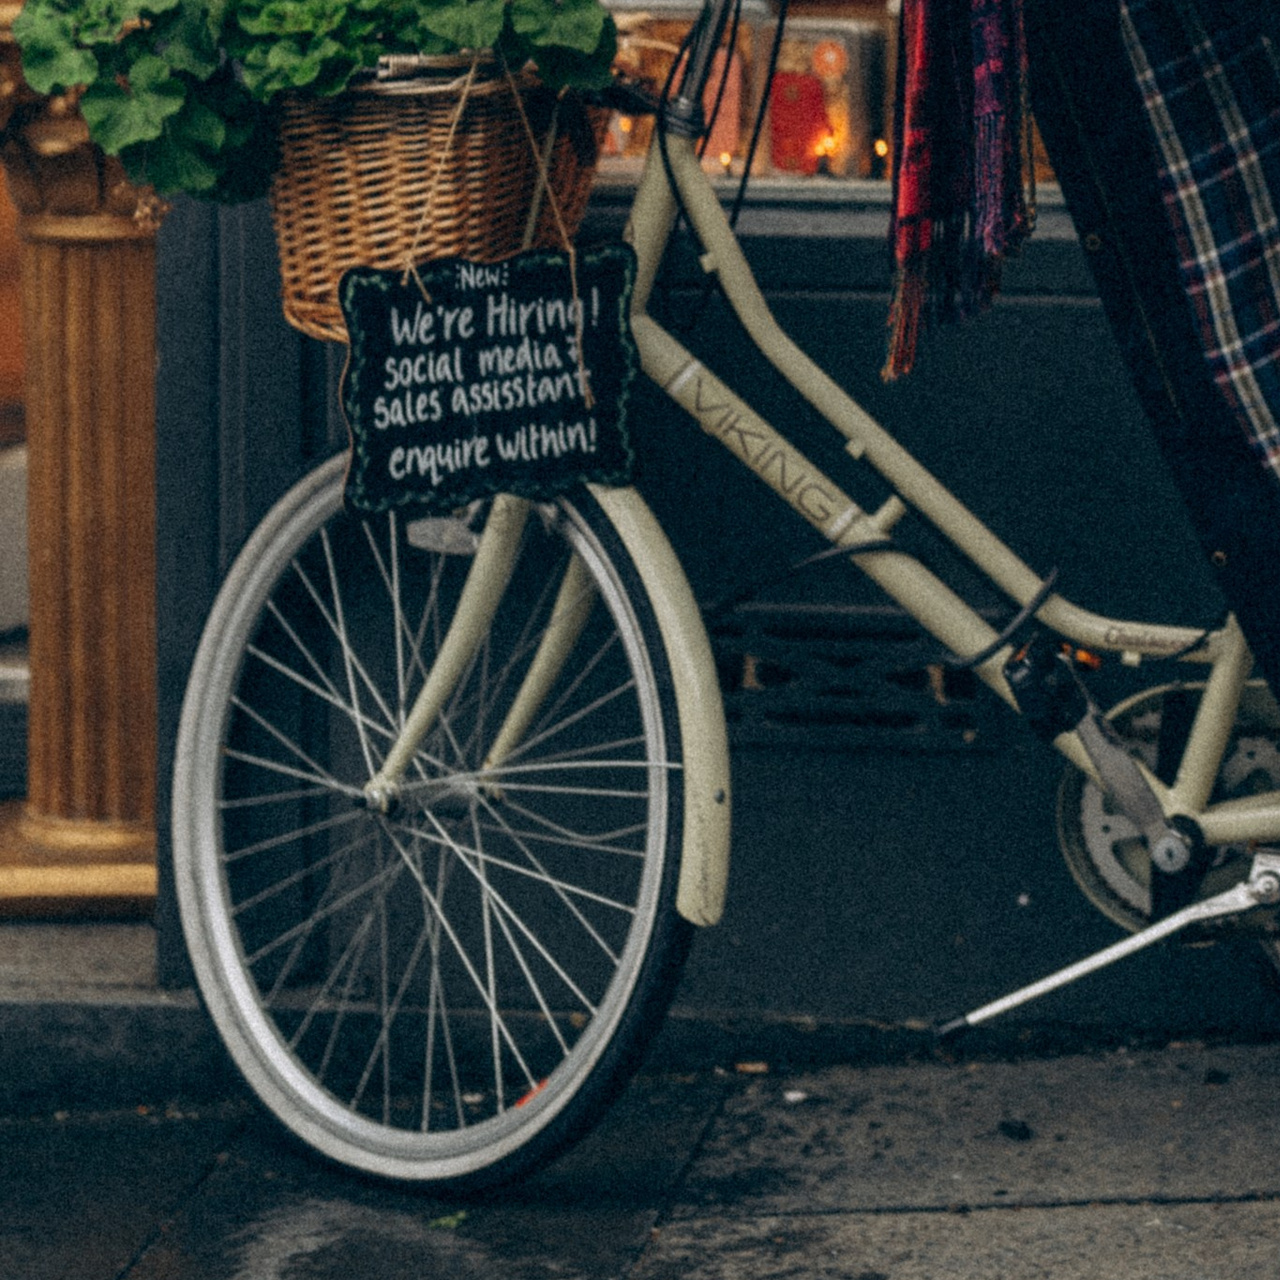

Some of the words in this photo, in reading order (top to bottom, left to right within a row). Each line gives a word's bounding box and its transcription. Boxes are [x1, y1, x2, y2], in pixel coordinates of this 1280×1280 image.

[391, 302, 475, 346] We're
[385, 346, 465, 391] social
[479, 336, 563, 376] media
[373, 390, 443, 430] sales
[388, 435, 490, 487] enquire
[495, 417, 597, 462] within!
[694, 377, 837, 521] VIKING
